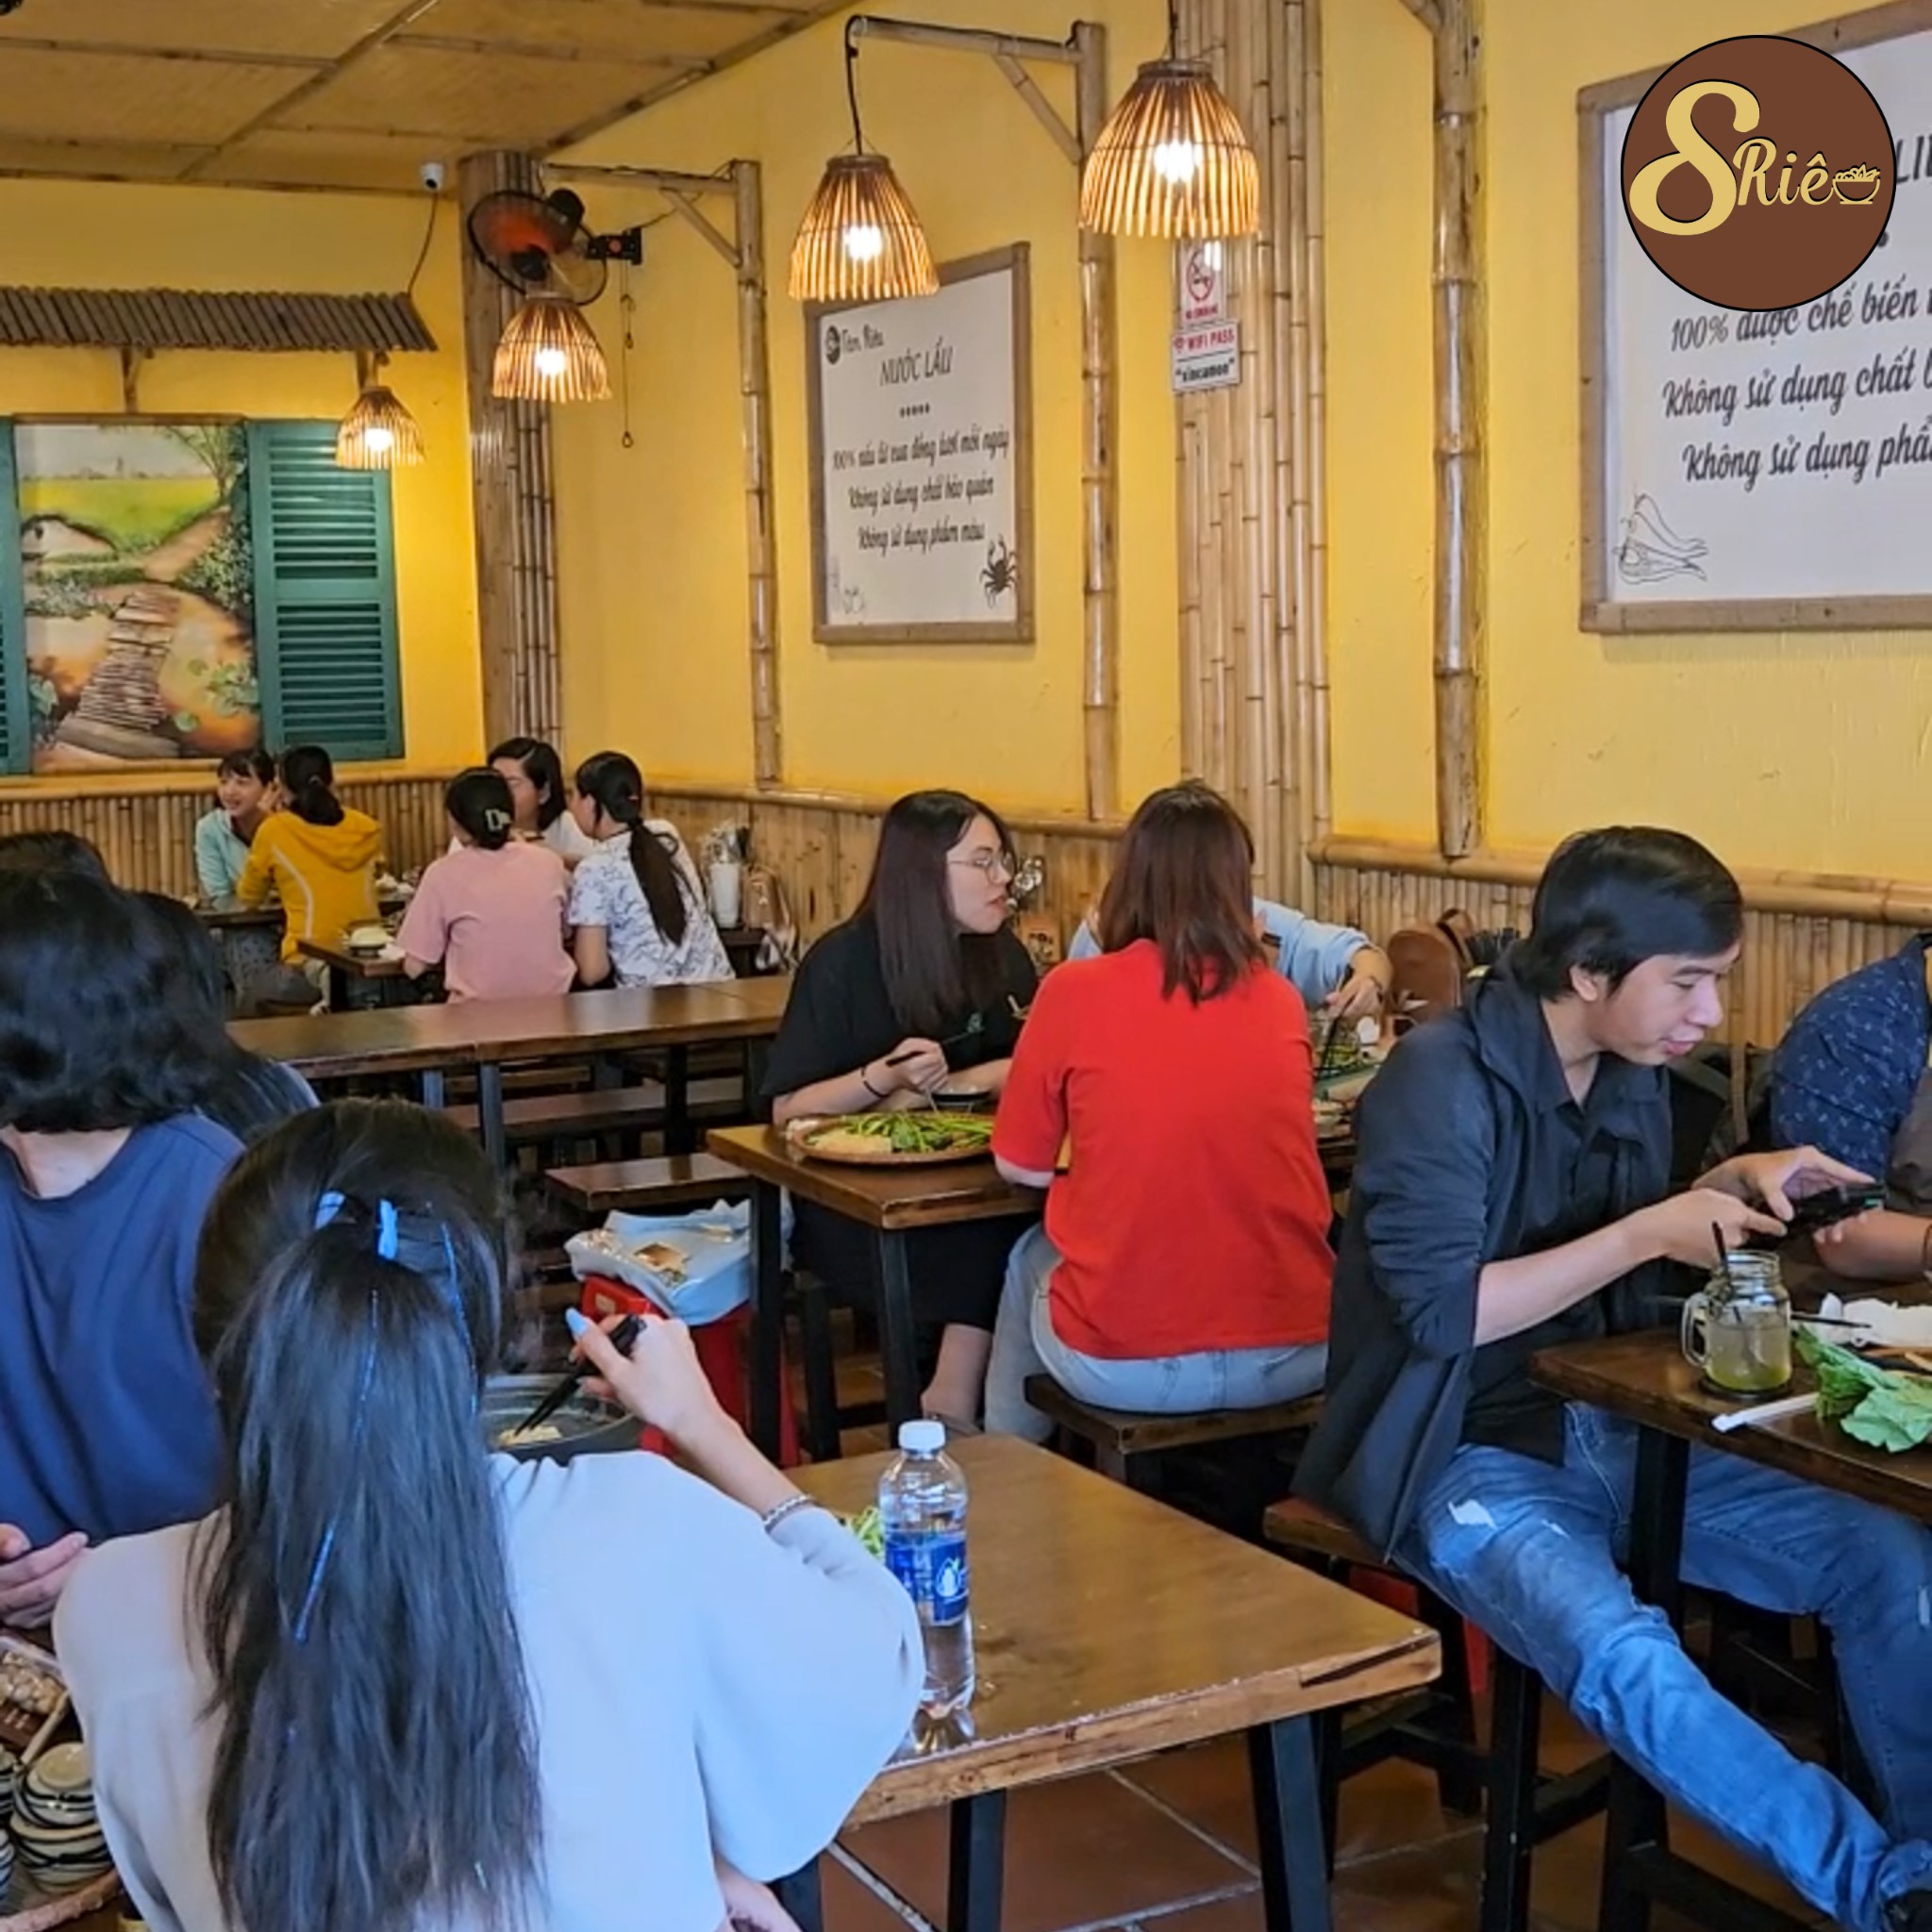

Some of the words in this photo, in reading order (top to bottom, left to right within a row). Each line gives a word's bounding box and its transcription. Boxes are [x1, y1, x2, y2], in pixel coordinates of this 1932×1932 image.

[1188, 334, 1208, 351] WIFI
[1210, 328, 1235, 347] PASS
[1671, 314, 1728, 352] 100%
[1807, 281, 1857, 332] chế
[1861, 273, 1919, 325] biến
[1661, 376, 1737, 426] Không
[1744, 367, 1777, 408] sử
[1781, 363, 1847, 416] dụng
[1855, 345, 1918, 397] chất
[1682, 441, 1760, 492] Không
[1768, 434, 1801, 475] sử
[1806, 430, 1870, 485] dụng
